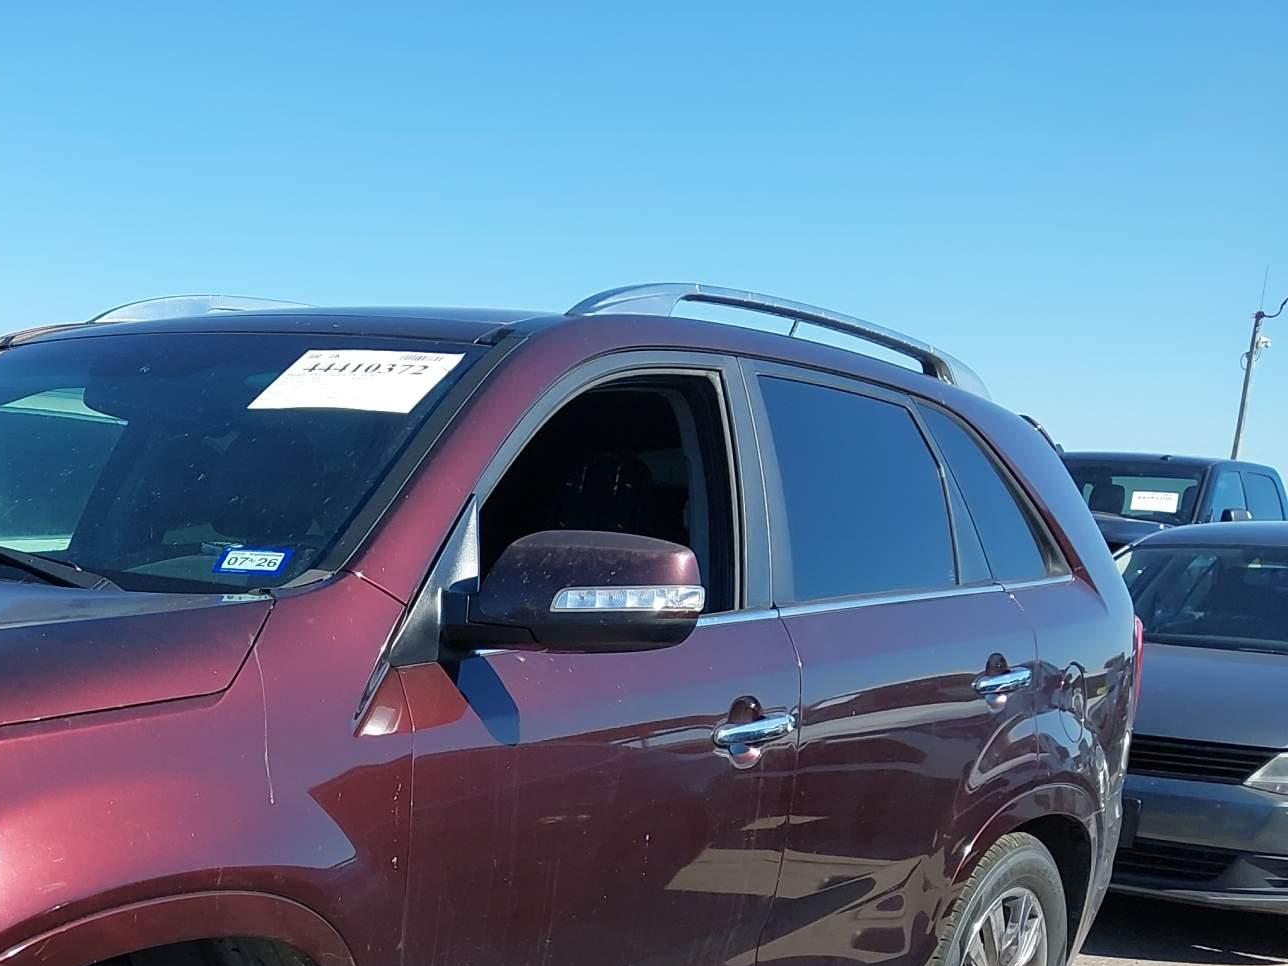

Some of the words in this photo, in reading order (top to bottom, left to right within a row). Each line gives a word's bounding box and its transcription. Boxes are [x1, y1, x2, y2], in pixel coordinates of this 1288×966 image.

[303, 362, 429, 375] 44410372
[227, 556, 249, 567] 07
[255, 557, 279, 568] 26
